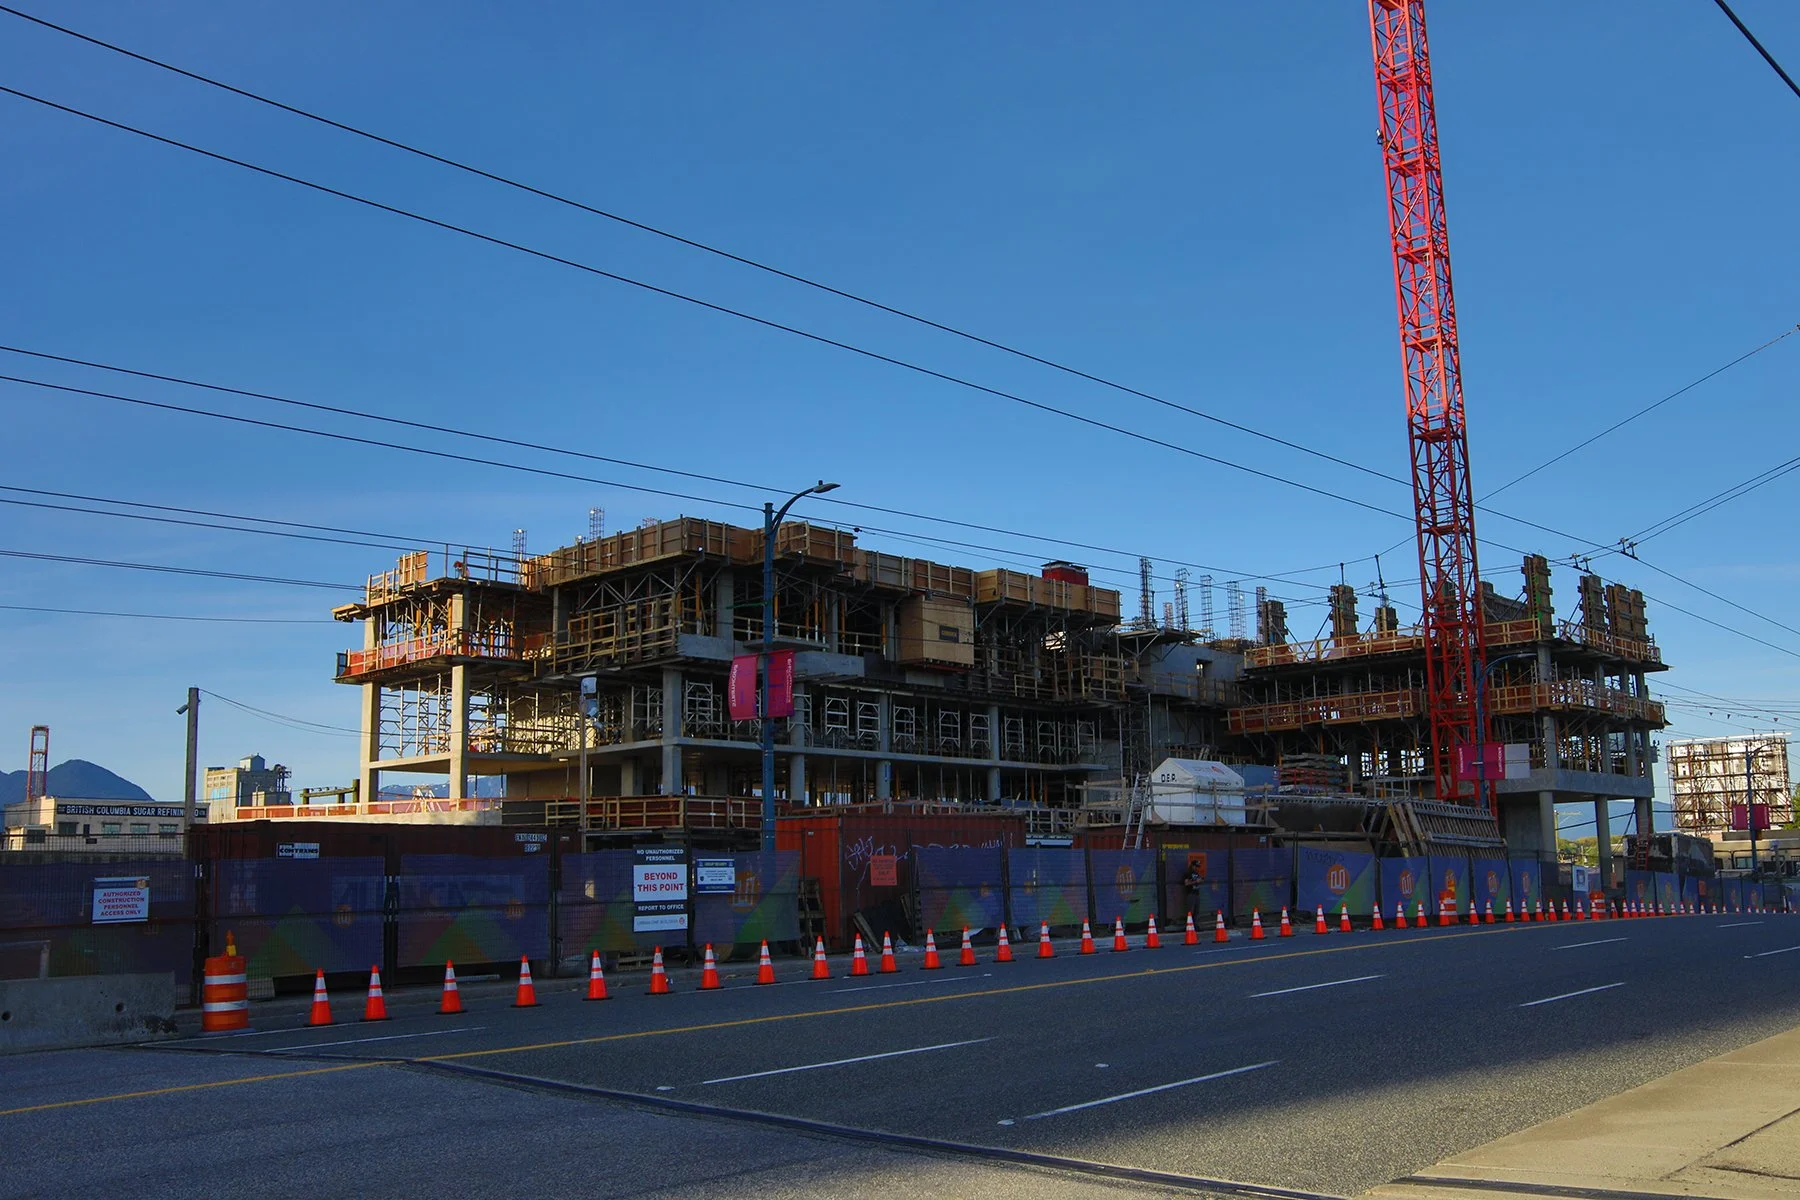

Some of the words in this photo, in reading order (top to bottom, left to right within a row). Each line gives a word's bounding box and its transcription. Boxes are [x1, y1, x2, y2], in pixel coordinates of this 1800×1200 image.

[66, 805, 94, 814] BRITISH
[96, 806, 131, 816] COLUMBIA
[132, 807, 156, 816] SUGAR
[157, 808, 184, 817] REFININ
[644, 872, 678, 880] BEYOND
